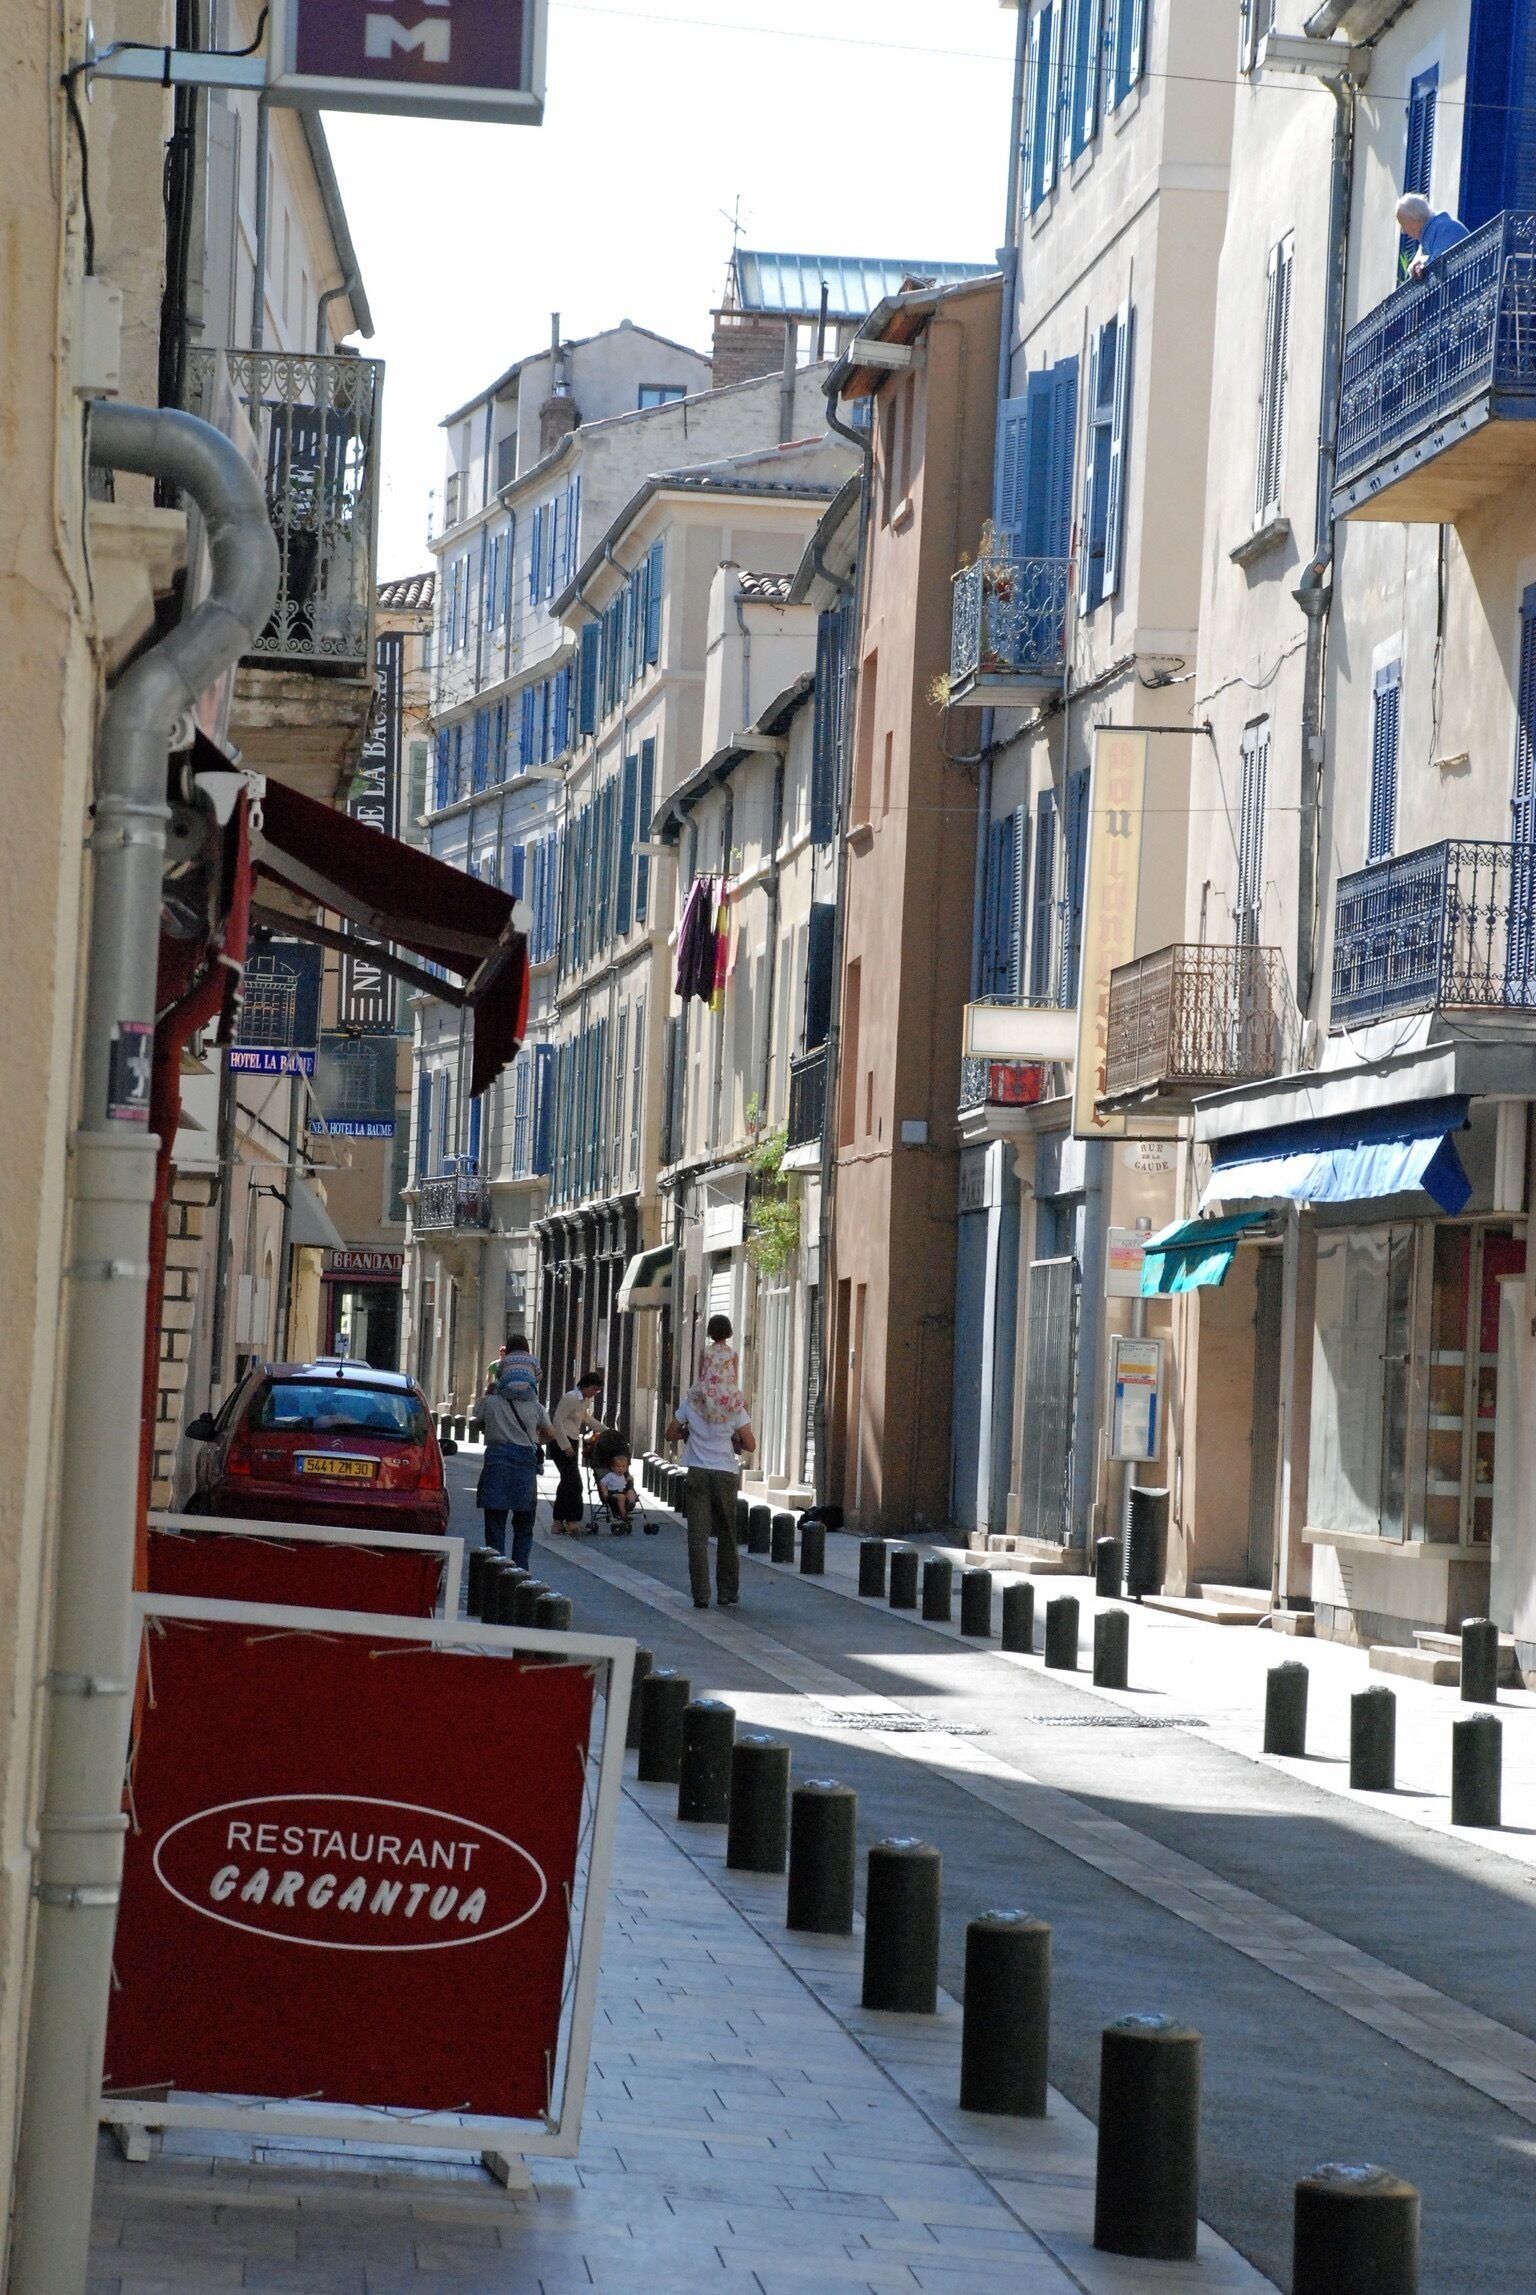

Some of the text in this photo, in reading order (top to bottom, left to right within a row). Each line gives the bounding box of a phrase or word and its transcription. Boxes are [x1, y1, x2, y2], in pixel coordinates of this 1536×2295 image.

[364, 0, 451, 64] M
[363, 765, 386, 798] LA
[230, 1052, 262, 1069] HOTEL
[264, 1054, 277, 1070] LA
[330, 1121, 355, 1135] HOTEL
[355, 1122, 365, 1136] LA
[367, 1123, 393, 1137] BAUME
[1140, 1143, 1163, 1153] RUE
[307, 1458, 334, 1473] 5441
[354, 1462, 369, 1476] 30
[226, 1821, 481, 1872] RESTAURANT
[209, 1864, 487, 1924] GARGANTUA
